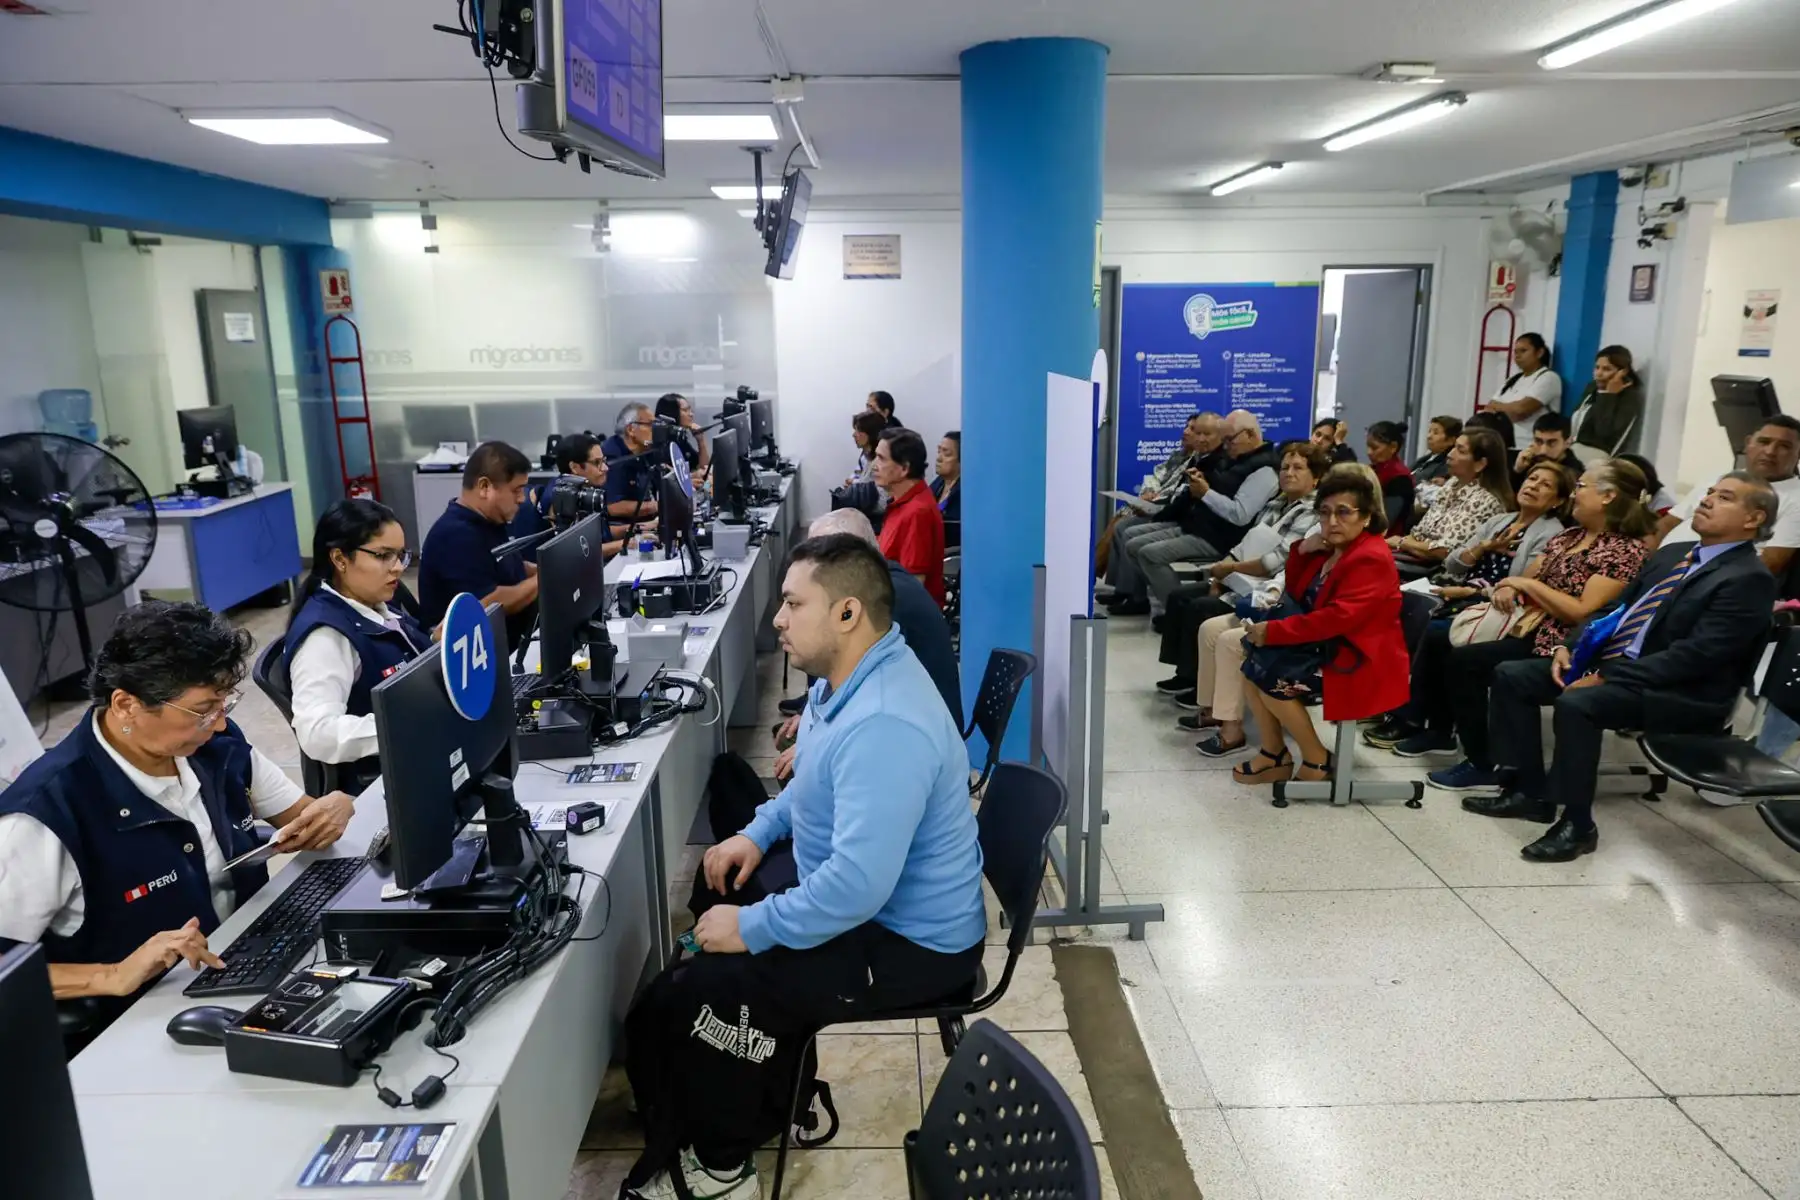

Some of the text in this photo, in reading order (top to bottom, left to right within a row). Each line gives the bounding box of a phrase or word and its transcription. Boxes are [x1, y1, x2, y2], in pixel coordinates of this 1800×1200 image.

[470, 345, 582, 368] migraciones
[1137, 439, 1166, 448] Agenda
[1137, 453, 1146, 461] en
[453, 624, 488, 691] 74
[148, 869, 178, 892] PERÚ
